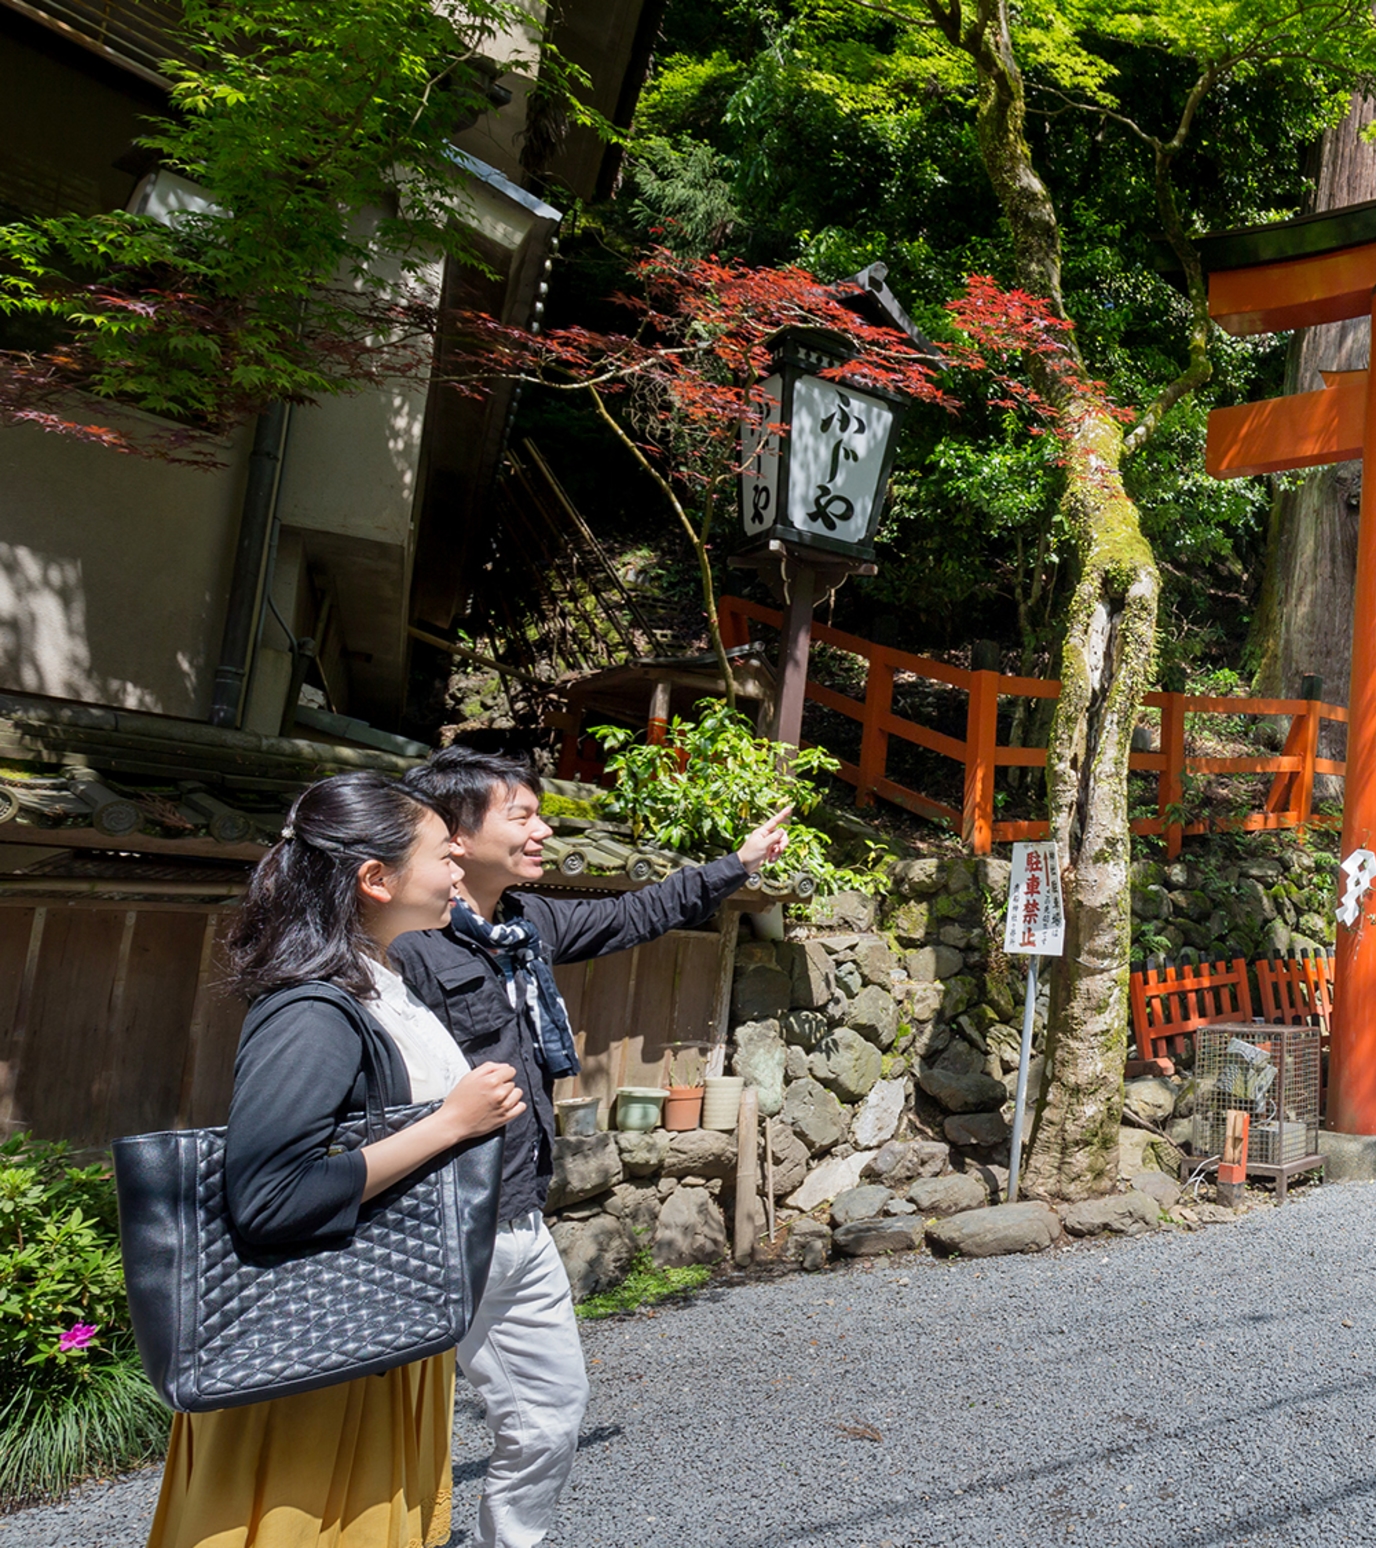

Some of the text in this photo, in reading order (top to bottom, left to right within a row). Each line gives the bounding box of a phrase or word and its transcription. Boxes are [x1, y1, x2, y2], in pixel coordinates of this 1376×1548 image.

[806, 389, 866, 532] ふじや
[1019, 850, 1043, 948] 駐車禁止
